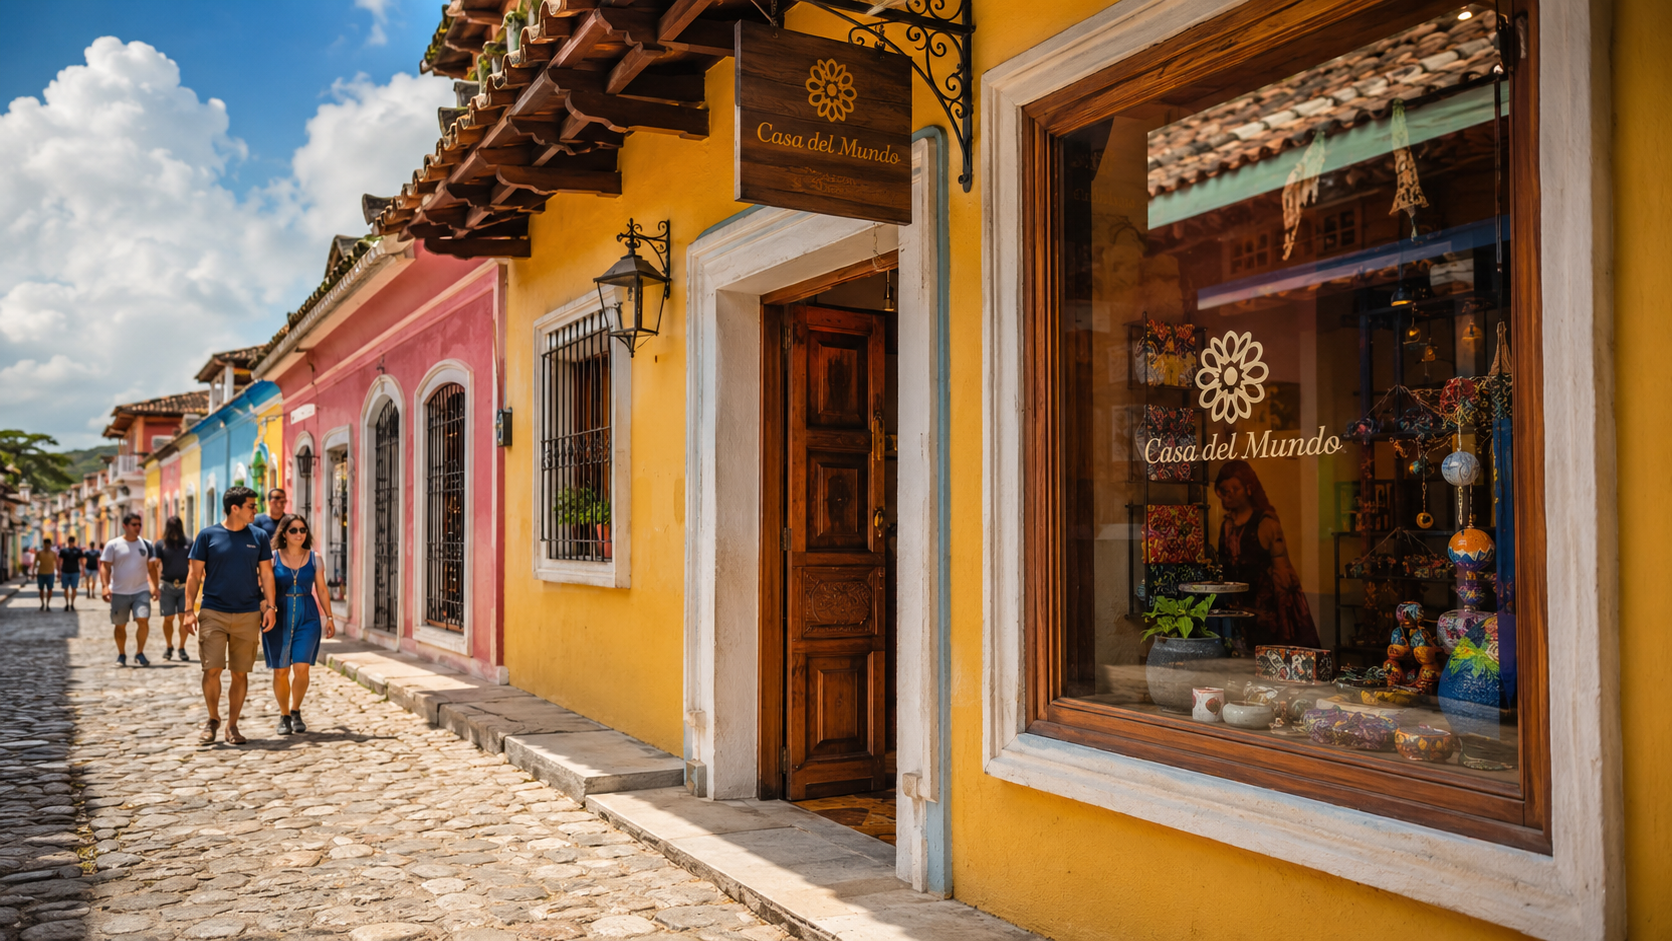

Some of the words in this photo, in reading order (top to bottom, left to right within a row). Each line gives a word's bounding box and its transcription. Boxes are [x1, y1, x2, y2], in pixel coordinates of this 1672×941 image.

[757, 121, 804, 149] Casa
[808, 132, 835, 155] del
[838, 136, 901, 164] Mundo
[1144, 437, 1199, 464] Casa
[1202, 433, 1238, 461] del
[1241, 425, 1343, 460] Mundo
